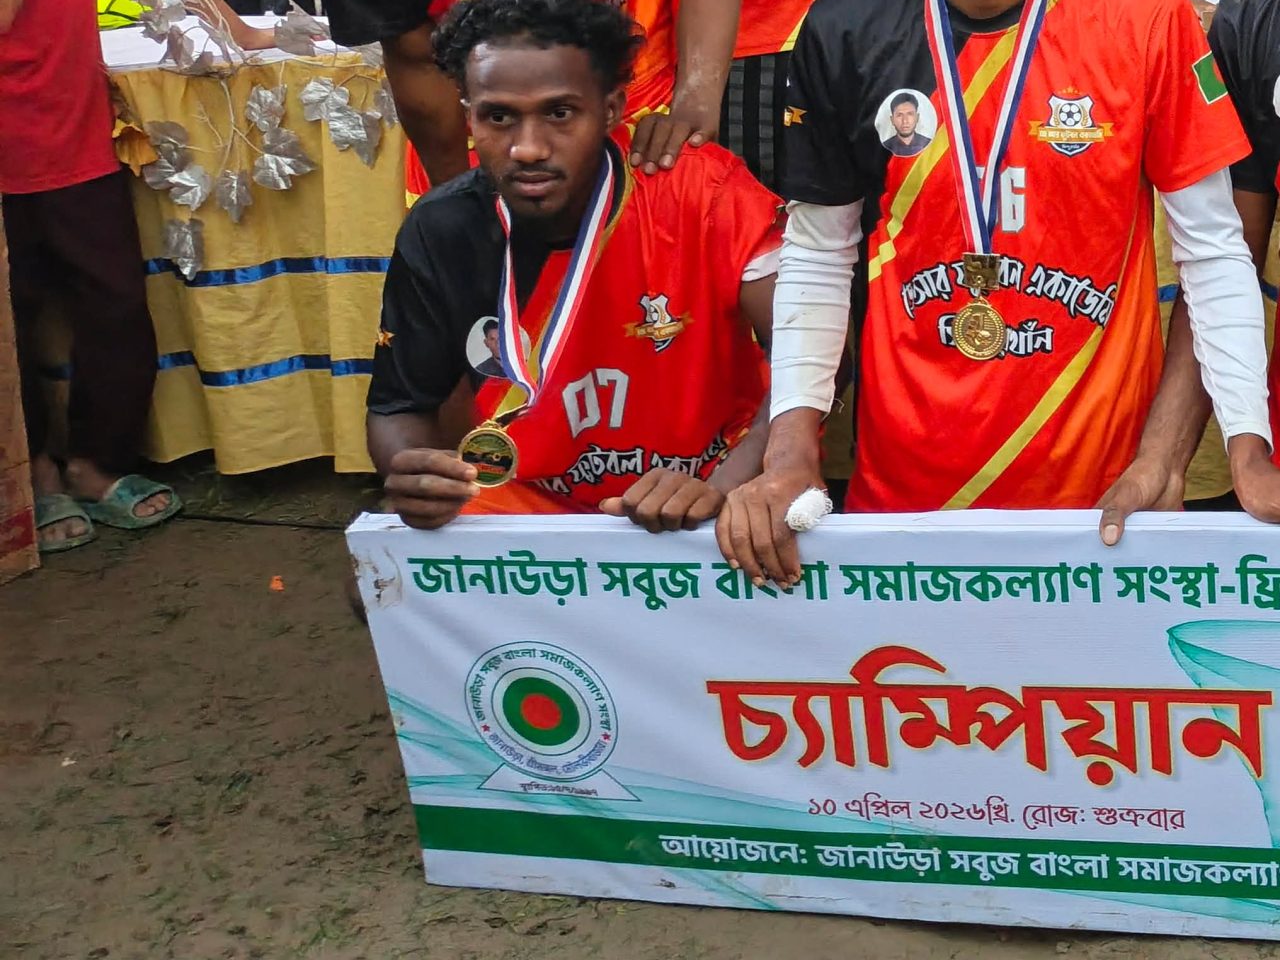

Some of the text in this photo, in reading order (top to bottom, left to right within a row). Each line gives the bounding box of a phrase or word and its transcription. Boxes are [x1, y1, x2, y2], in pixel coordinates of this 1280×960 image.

[562, 367, 630, 439] 07
[566, 444, 644, 485] ফুটবল
[408, 550, 589, 606] জানাউড়া
[597, 561, 702, 610] সবুজ
[839, 561, 1103, 603] সমাজকল্যাণ
[705, 644, 1274, 788] চ্যাম্পিয়ান
[808, 796, 837, 817] ১০
[845, 792, 911, 822] এপ্রিল
[1092, 806, 1186, 831] শুক্রবার
[658, 834, 808, 865] আয়োজনে:
[815, 841, 941, 877] জানাউড়া
[950, 850, 1020, 882] সবুজ
[1028, 852, 1109, 880] বাংলা
